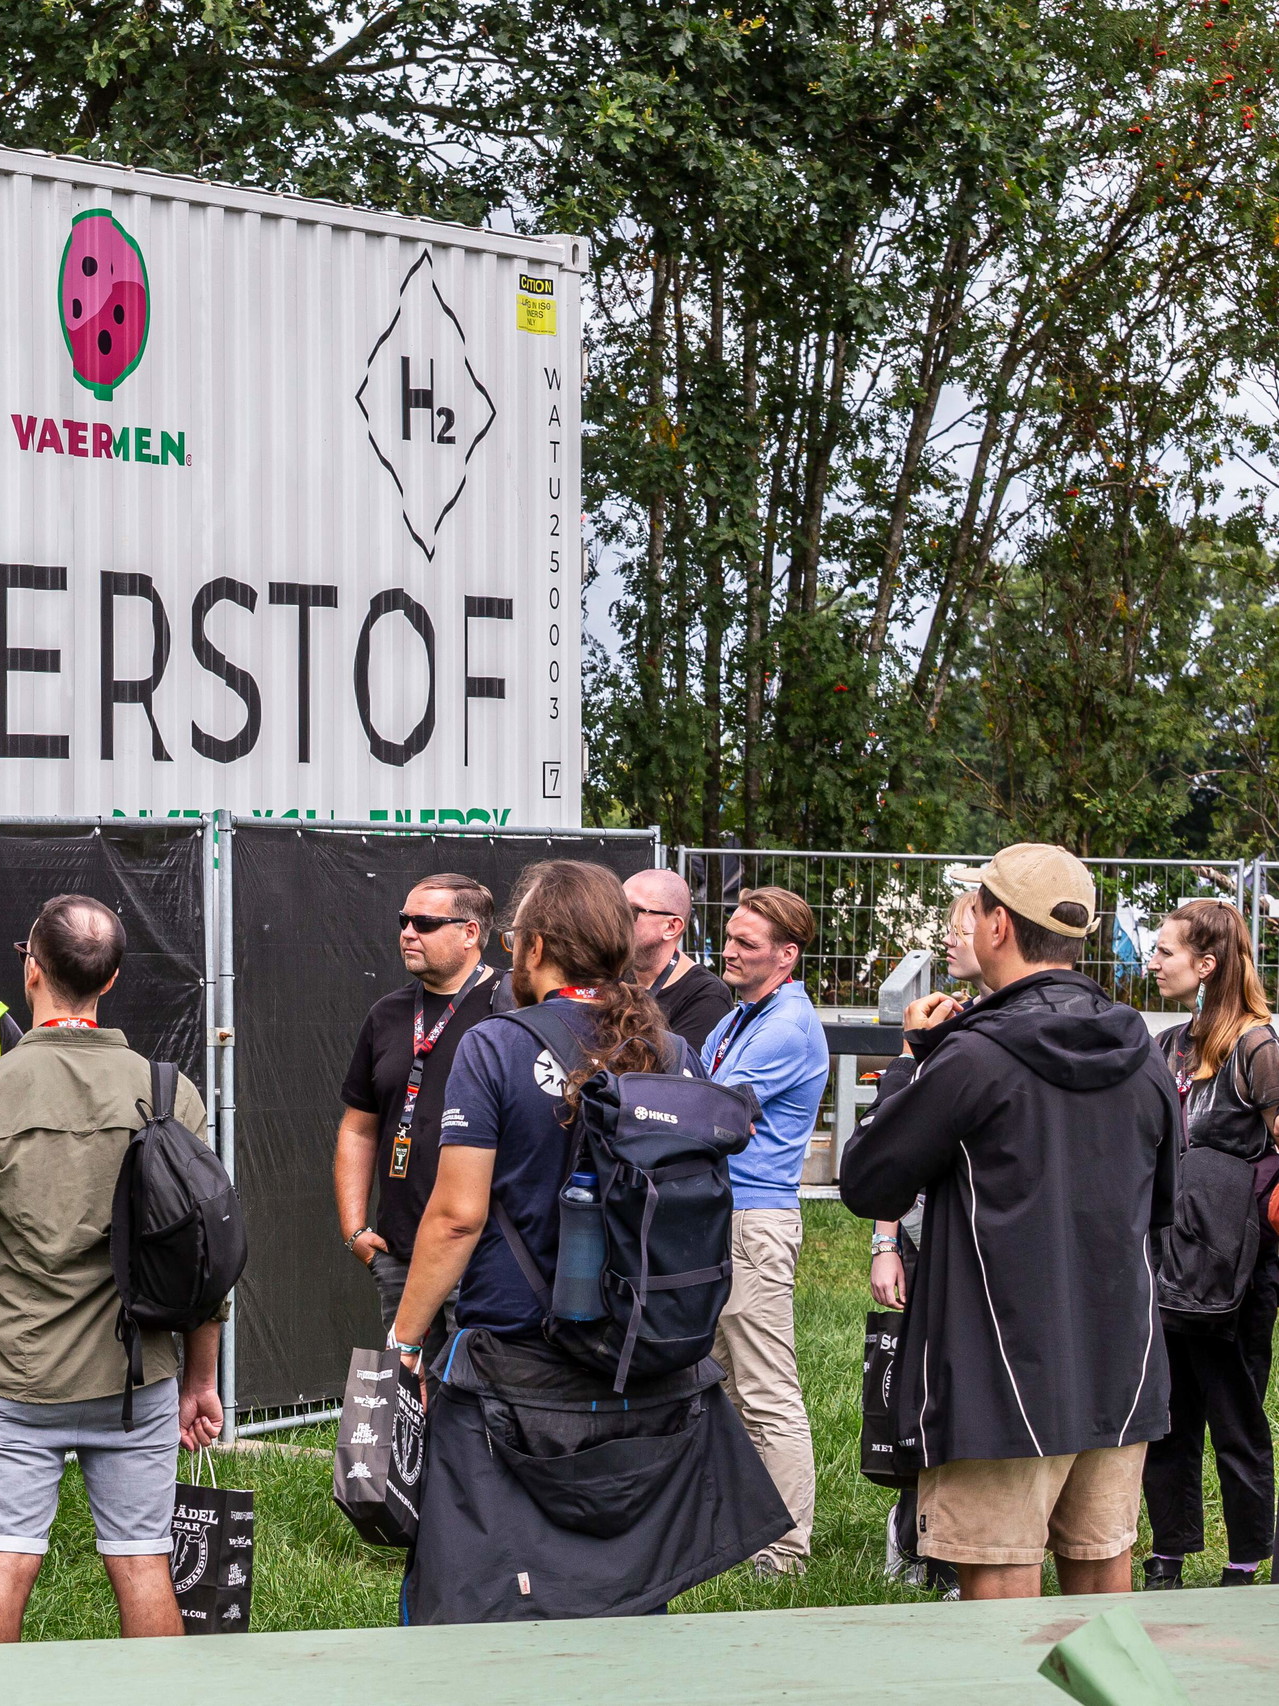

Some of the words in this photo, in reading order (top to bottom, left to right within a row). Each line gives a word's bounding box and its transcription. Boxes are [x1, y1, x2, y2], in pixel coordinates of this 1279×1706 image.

[648, 1110, 678, 1124] HKES
[172, 1504, 219, 1525] ÄDEL
[179, 1609, 207, 1619] H.COM
